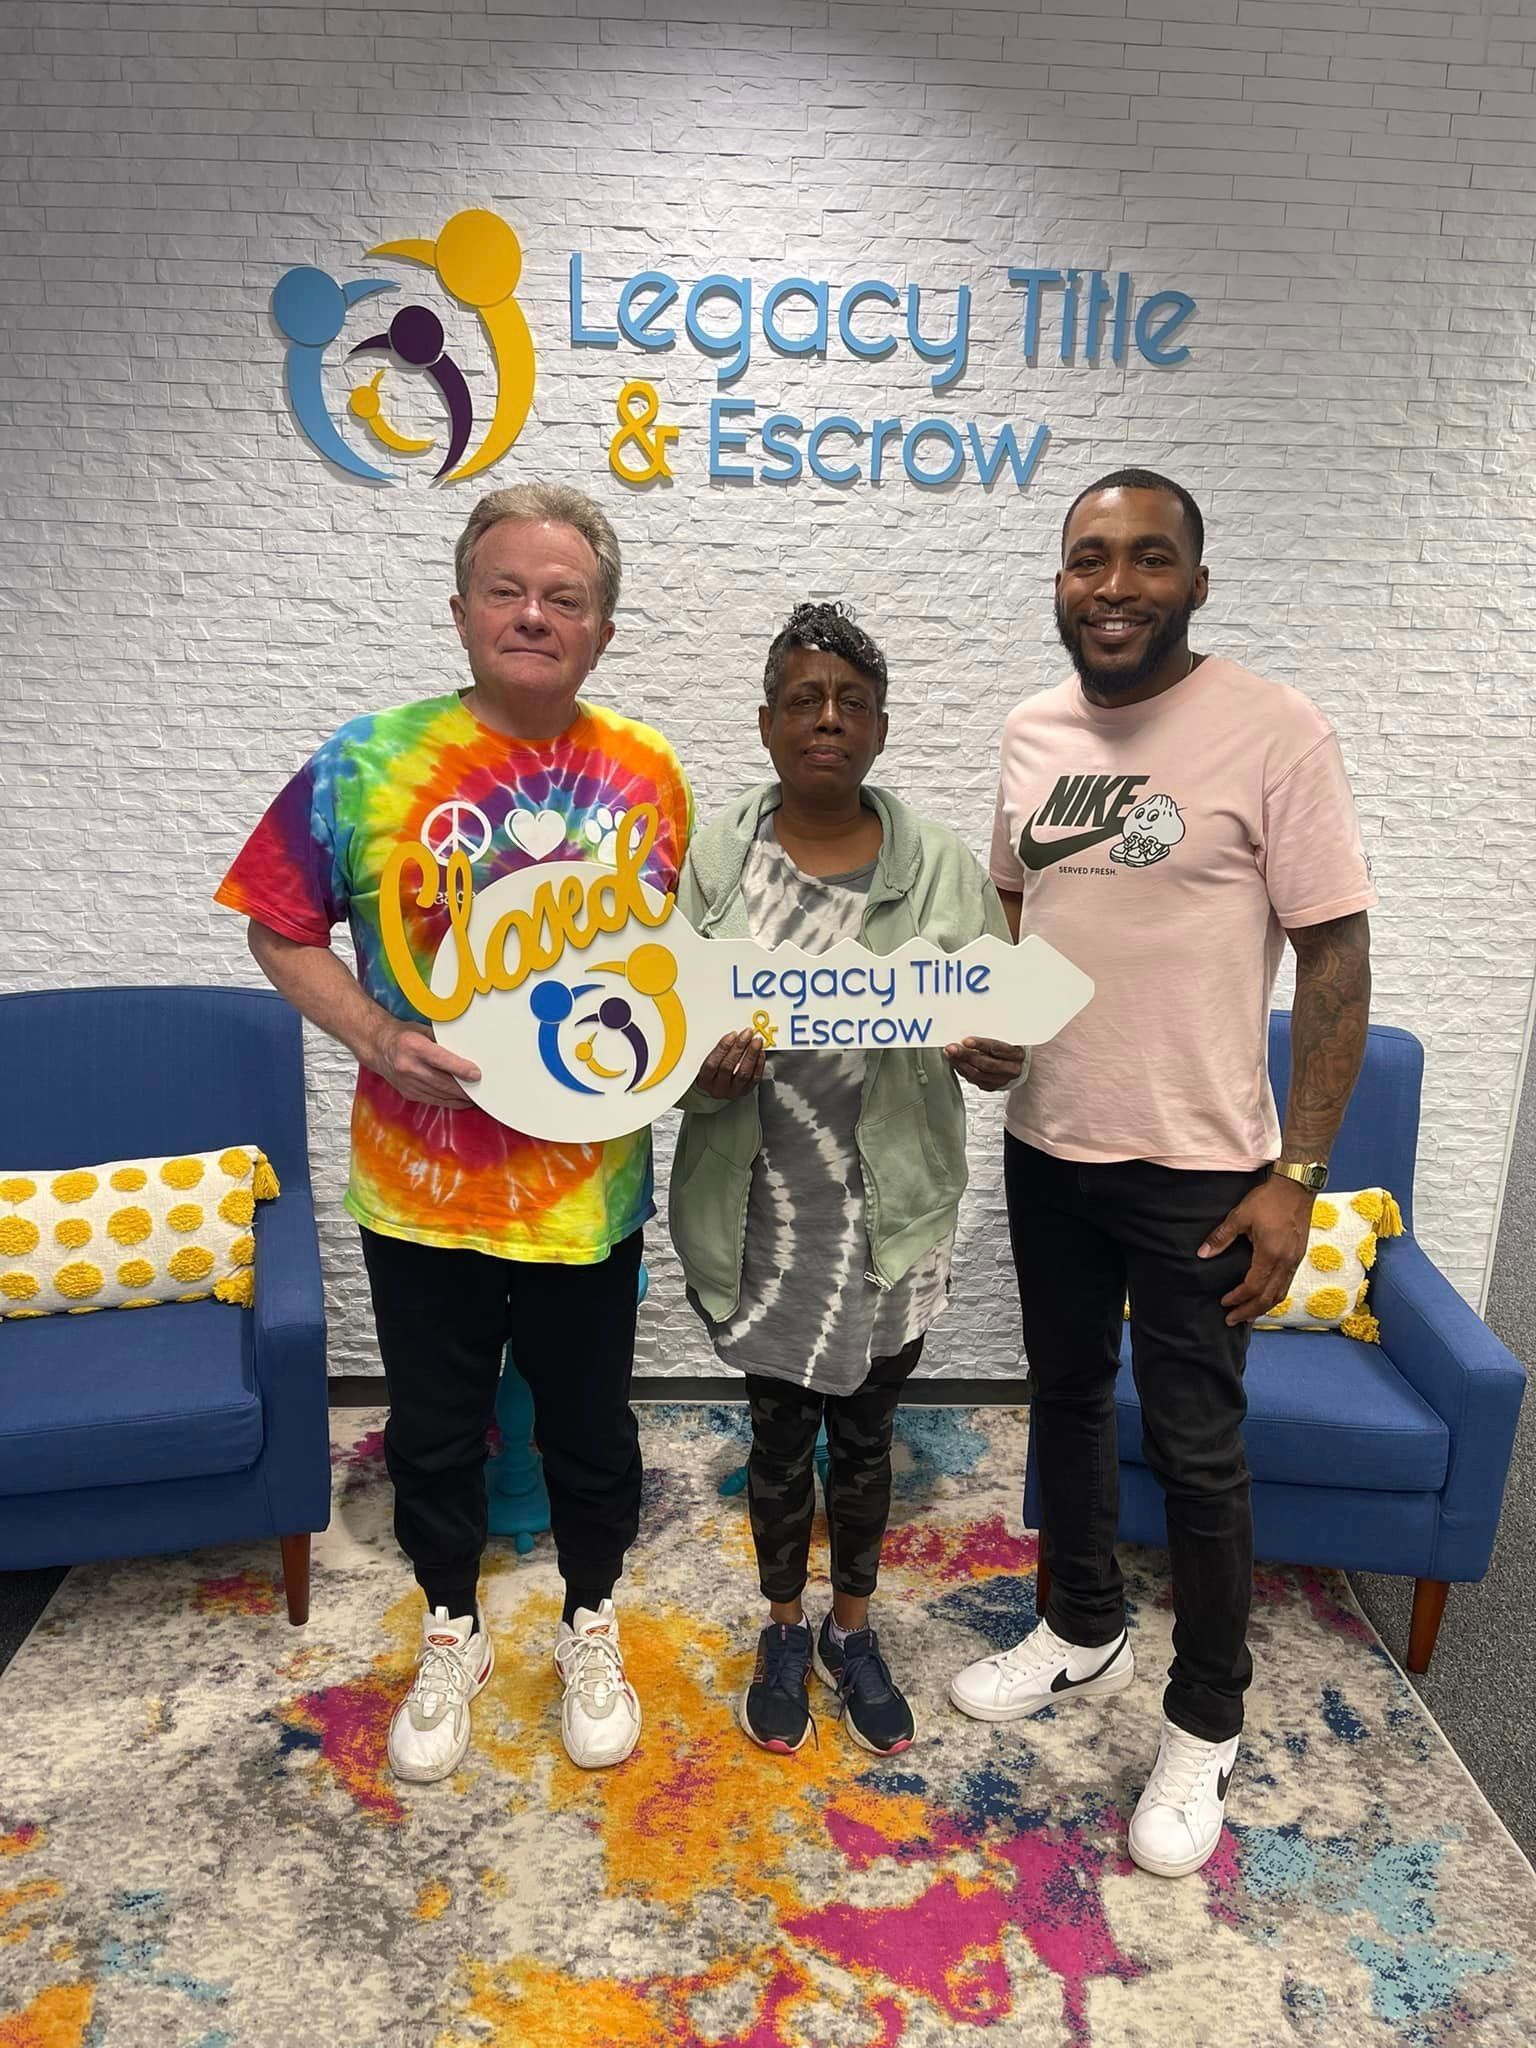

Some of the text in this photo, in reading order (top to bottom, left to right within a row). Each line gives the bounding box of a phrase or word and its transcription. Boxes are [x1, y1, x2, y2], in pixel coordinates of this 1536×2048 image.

[569, 253, 1197, 390] Legacy Title
[608, 381, 1052, 486] & Escrow
[1035, 775, 1151, 828] NIKE
[1058, 866, 1118, 876] SERVED FRESH.
[379, 802, 676, 1021] Closed
[732, 959, 992, 1007] Legacy Title
[750, 1010, 934, 1048] & Escrow
